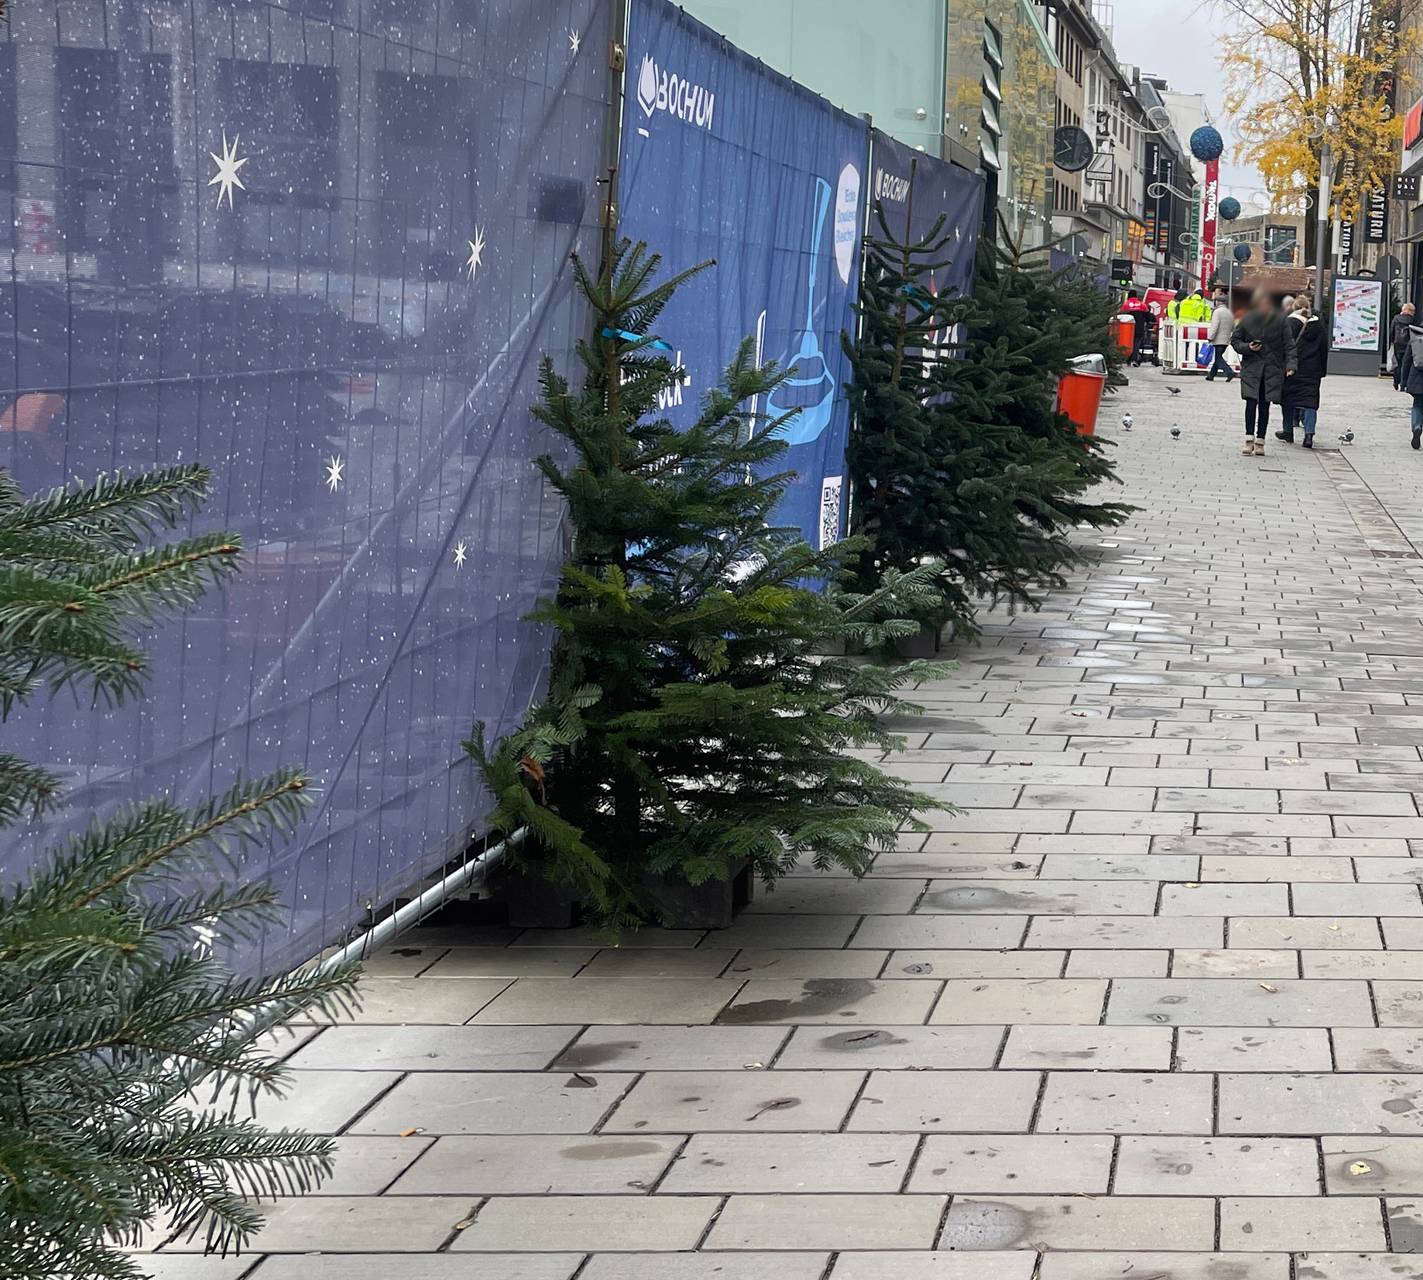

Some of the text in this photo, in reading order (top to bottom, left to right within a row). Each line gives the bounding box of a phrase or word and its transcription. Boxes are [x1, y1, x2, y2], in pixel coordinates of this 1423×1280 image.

[655, 66, 715, 130] BOCHUM
[882, 173, 910, 203] BOCHUM
[1370, 186, 1386, 238] SATURN
[1190, 190, 1200, 261] DEICHMANN
